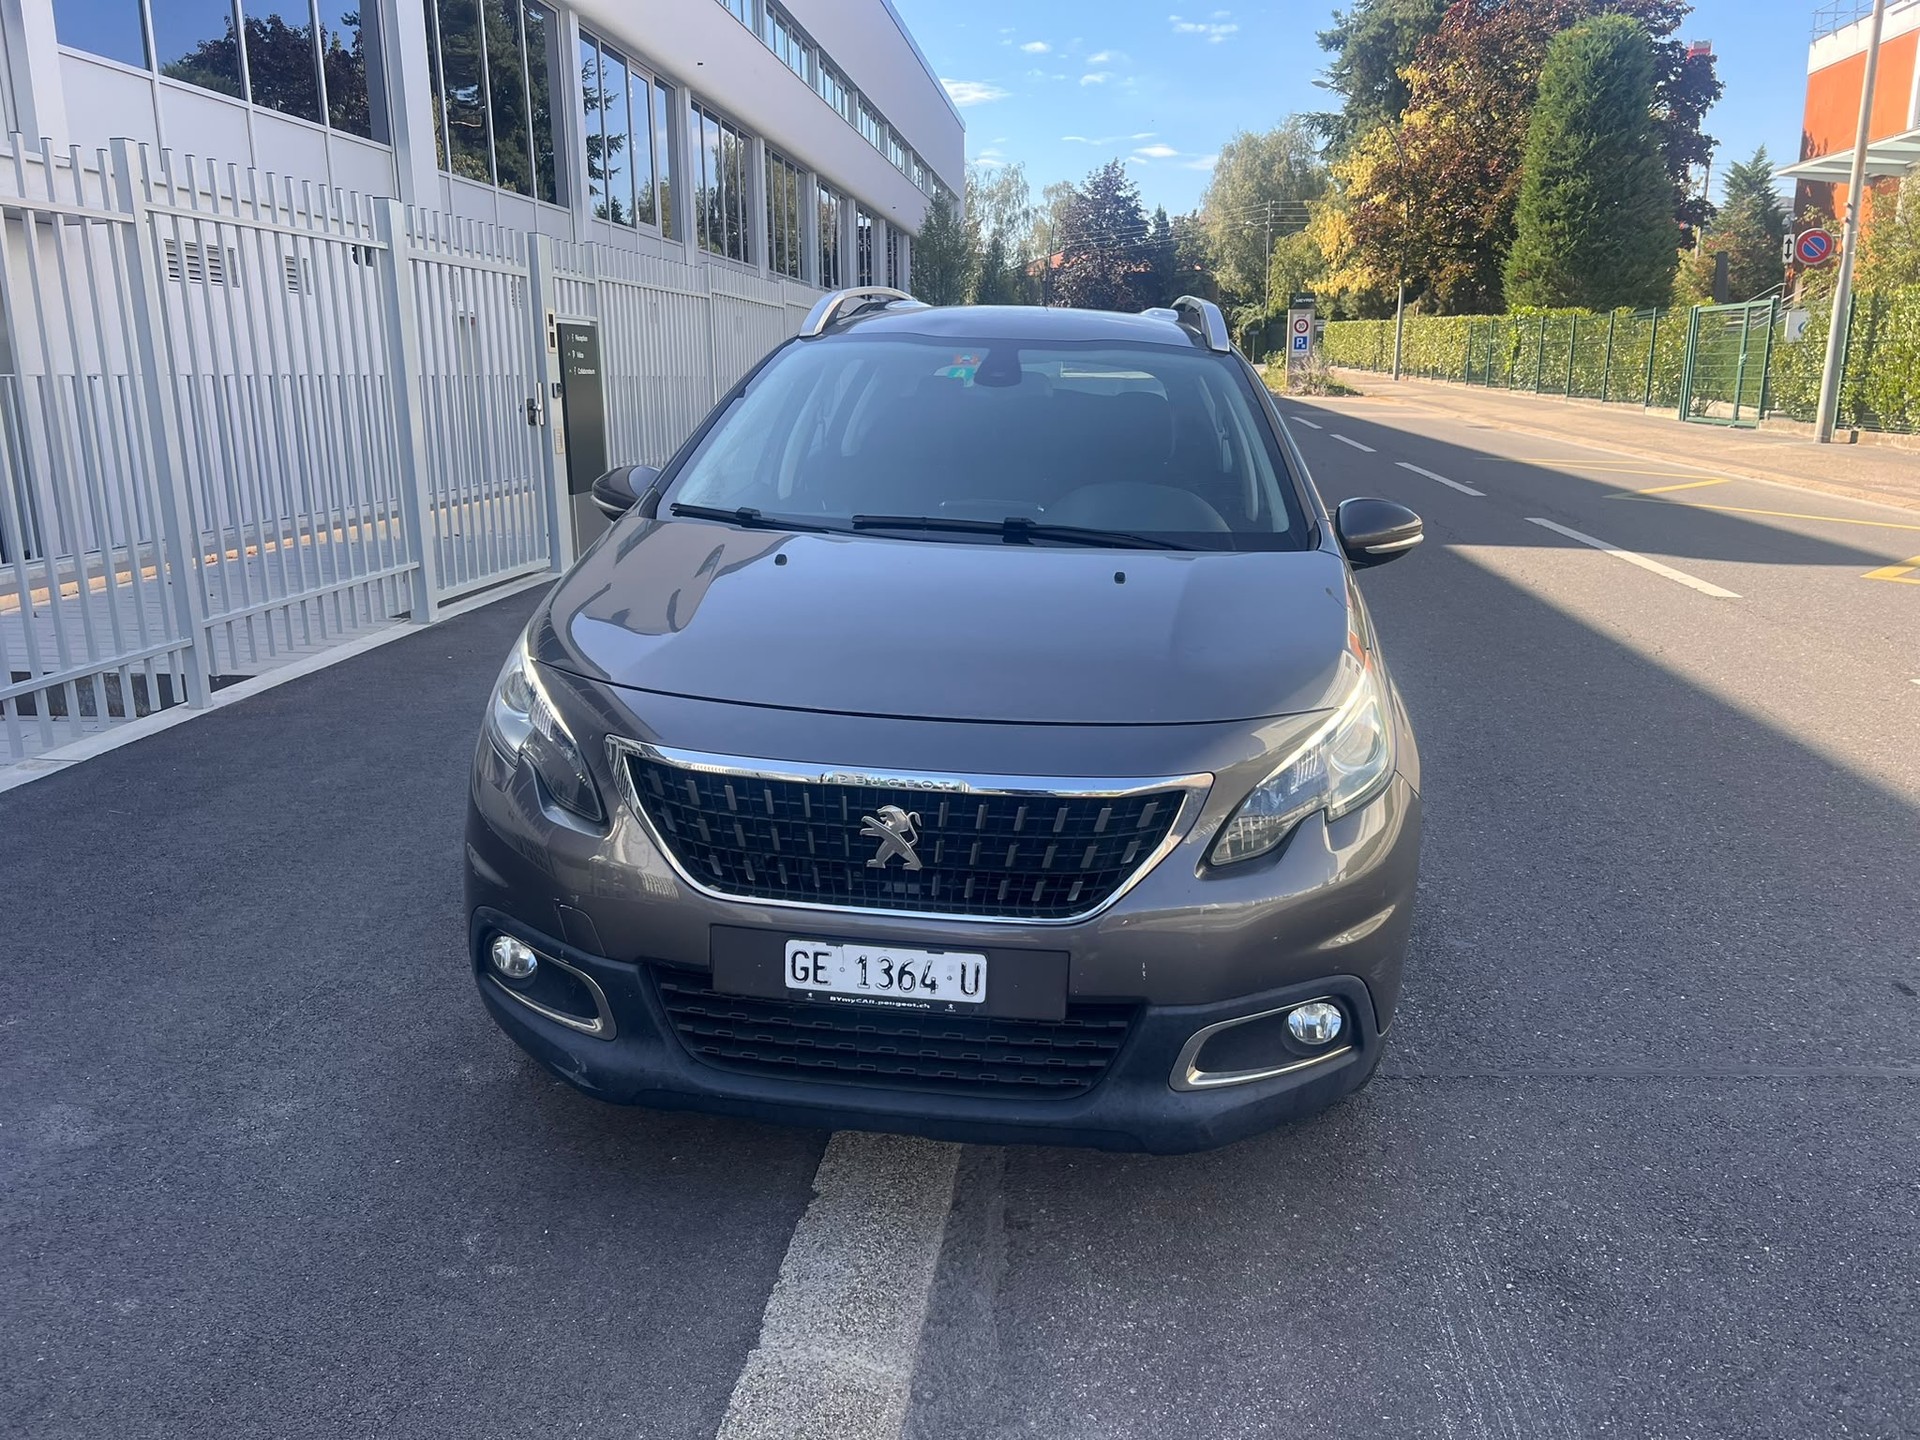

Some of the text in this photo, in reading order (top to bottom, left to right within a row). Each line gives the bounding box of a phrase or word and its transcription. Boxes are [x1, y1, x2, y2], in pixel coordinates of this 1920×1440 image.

[838, 774, 950, 790] PEUGEOT
[791, 950, 981, 998] GE 1364 U
